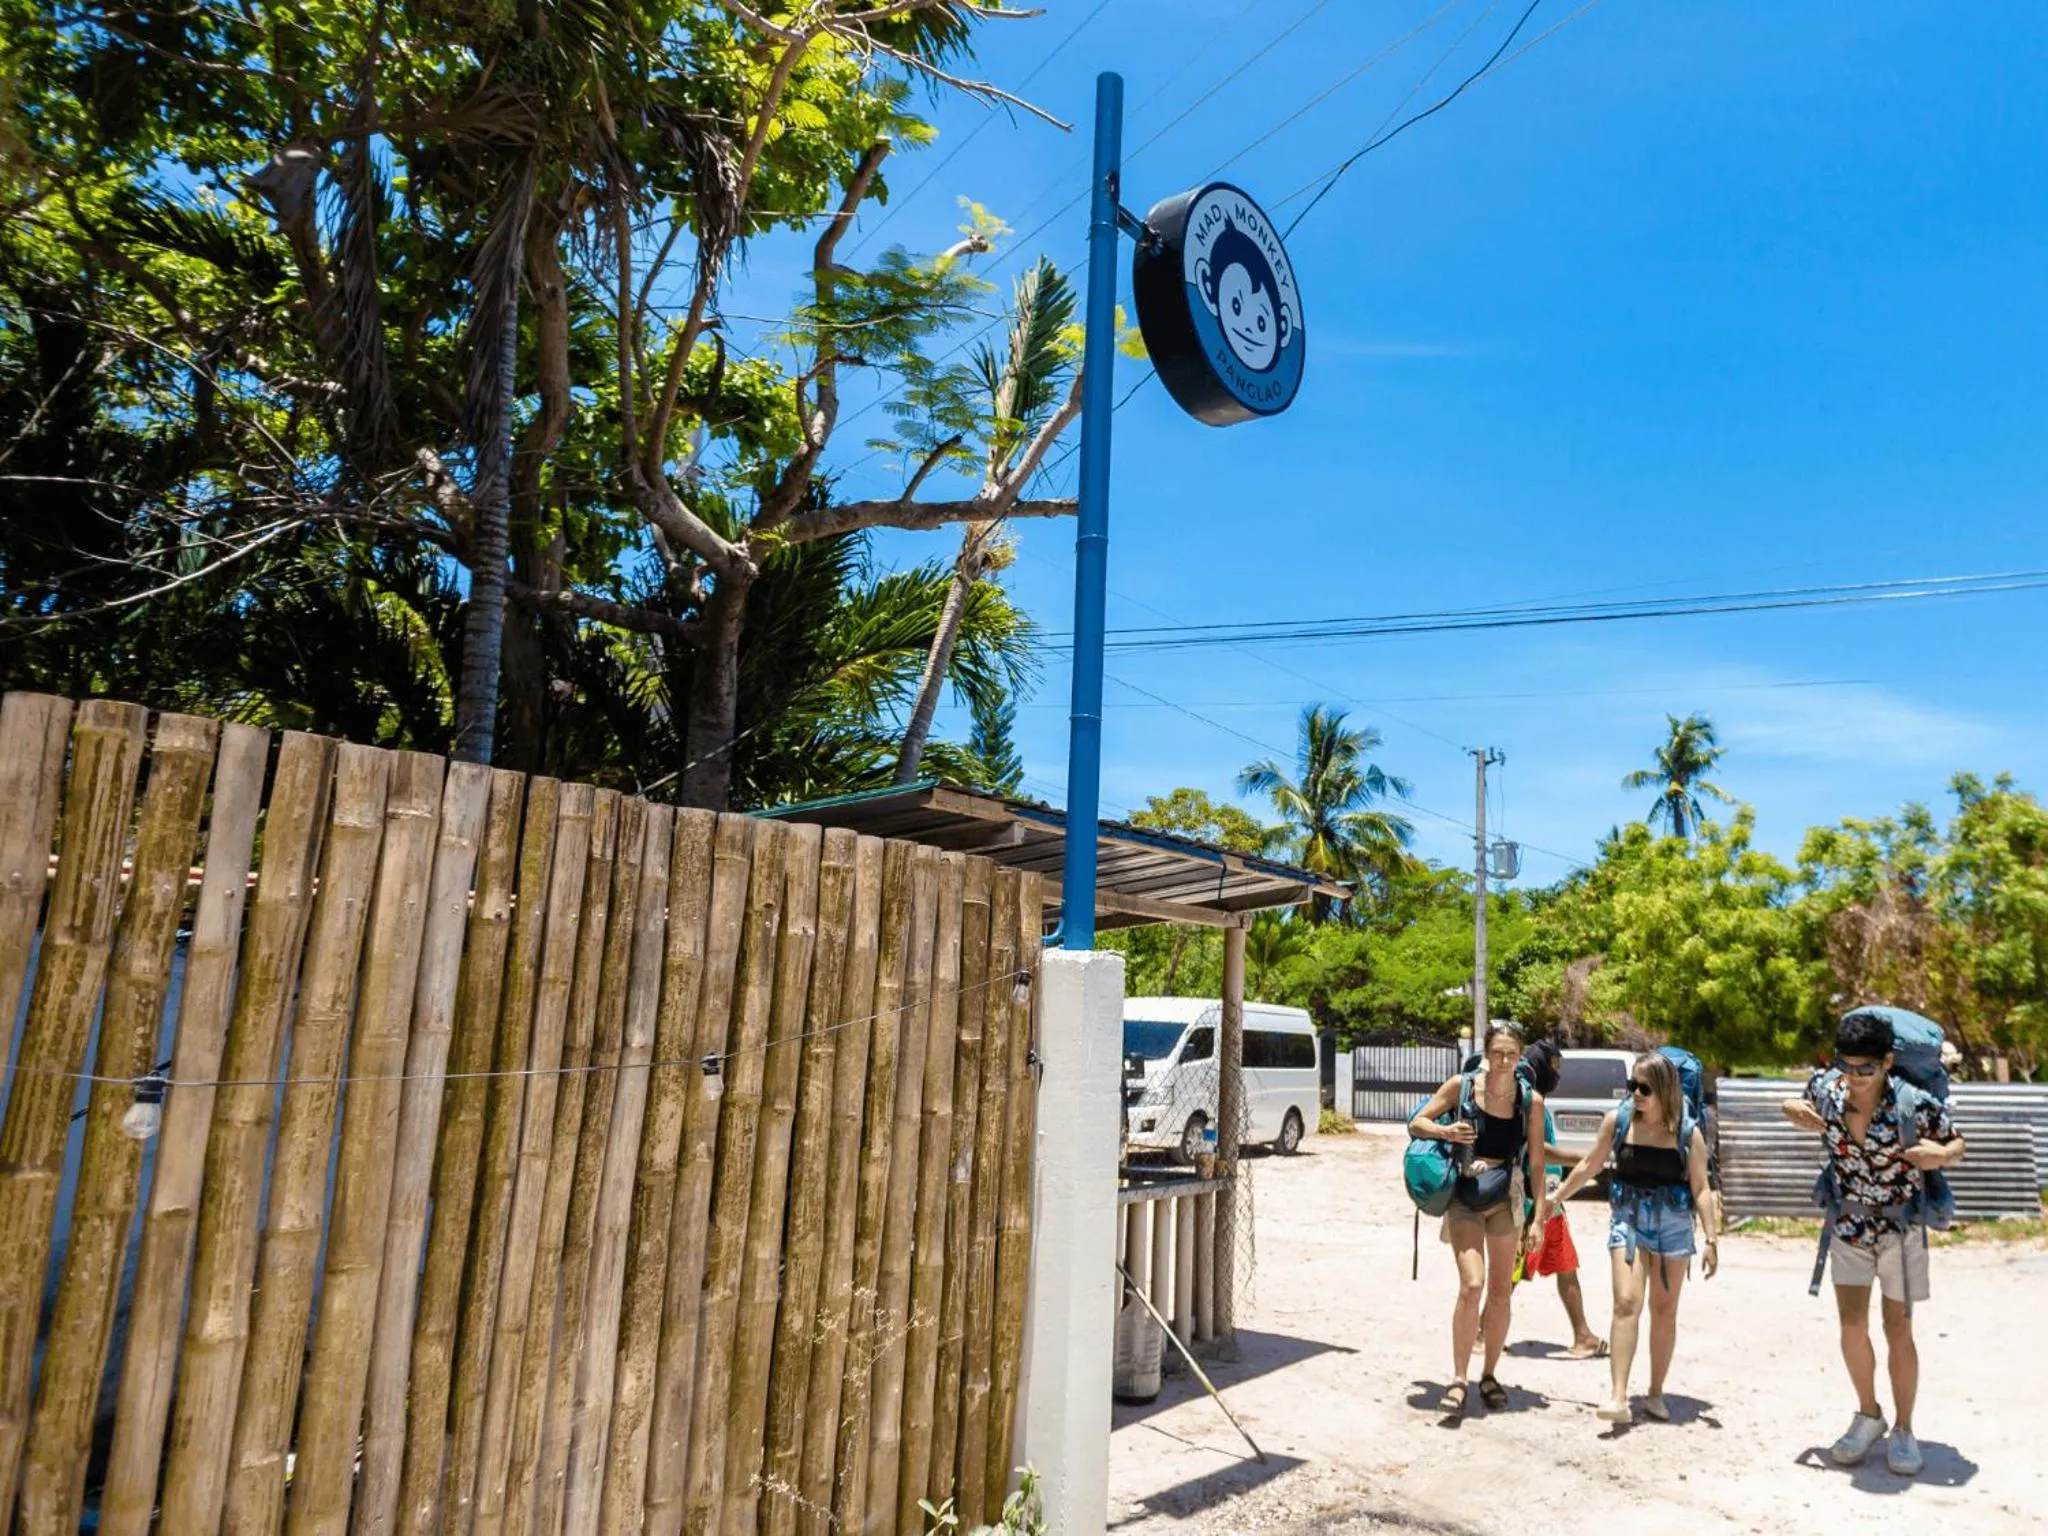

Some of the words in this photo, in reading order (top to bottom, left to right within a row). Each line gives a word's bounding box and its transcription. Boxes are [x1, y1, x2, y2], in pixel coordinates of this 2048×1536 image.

[1195, 204, 1222, 247] MAD
[1235, 203, 1290, 289] MONKEY
[1216, 350, 1282, 402] PANGLAO
